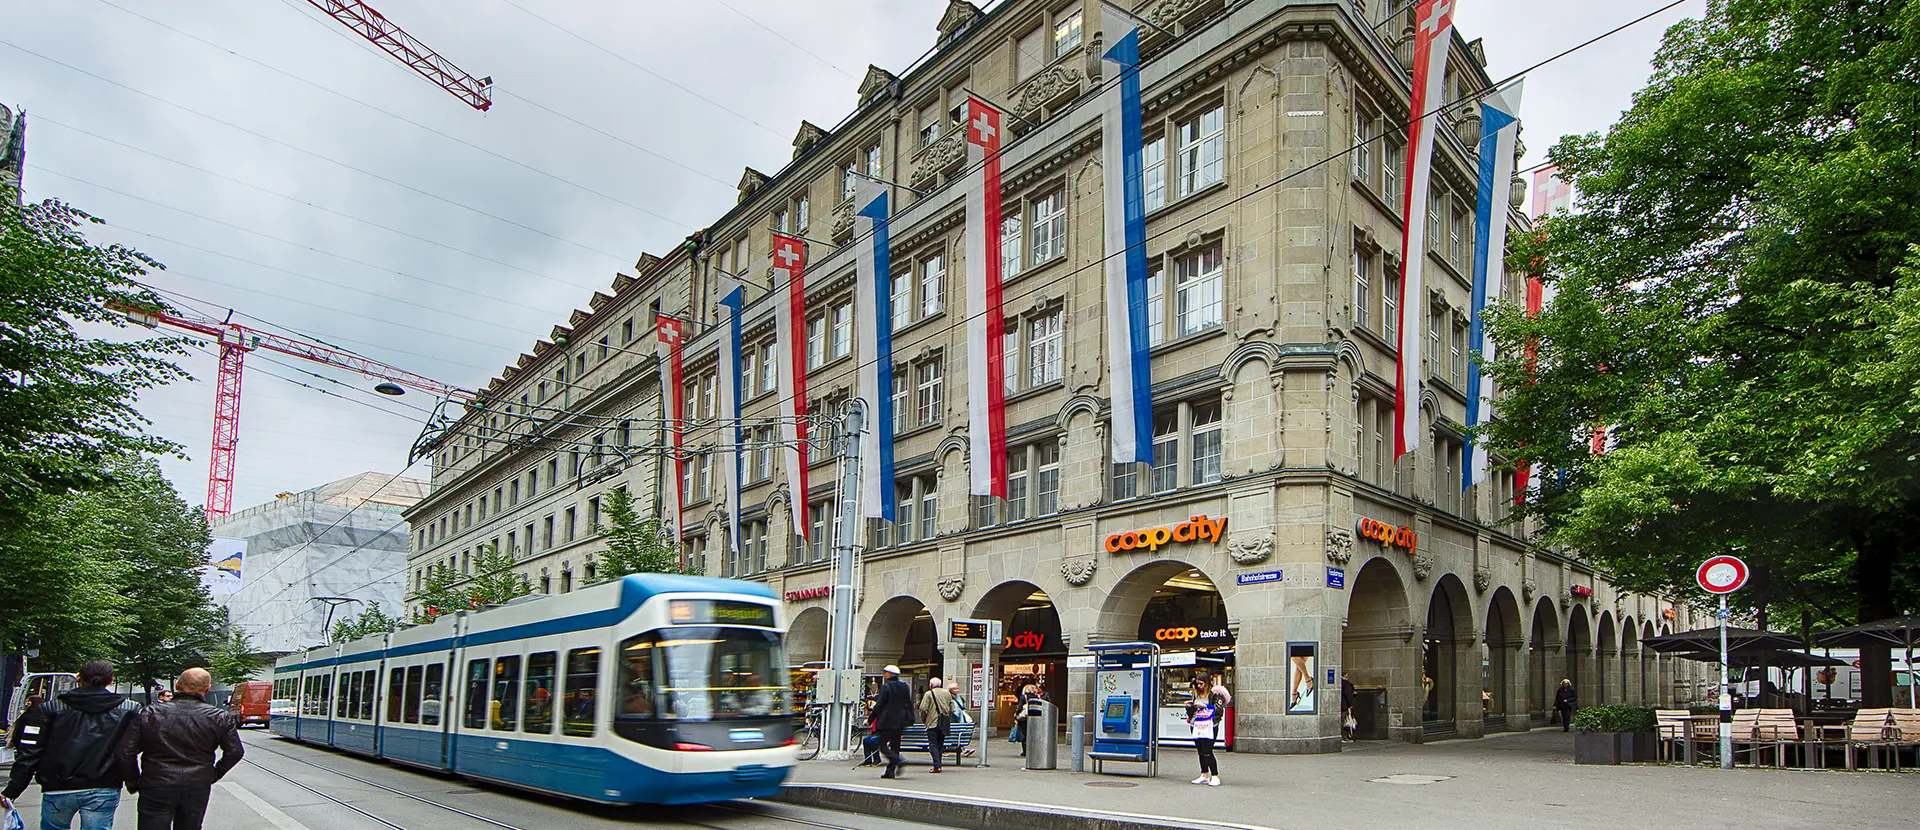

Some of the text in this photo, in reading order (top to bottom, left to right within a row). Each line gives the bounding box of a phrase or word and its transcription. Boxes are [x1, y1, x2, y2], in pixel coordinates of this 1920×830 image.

[1104, 514, 1228, 553] coop city
[1361, 517, 1418, 555] coop city
[1240, 572, 1278, 583] Bahnhofstrasse
[1013, 630, 1045, 651] city
[1155, 626, 1227, 642] coop take it
